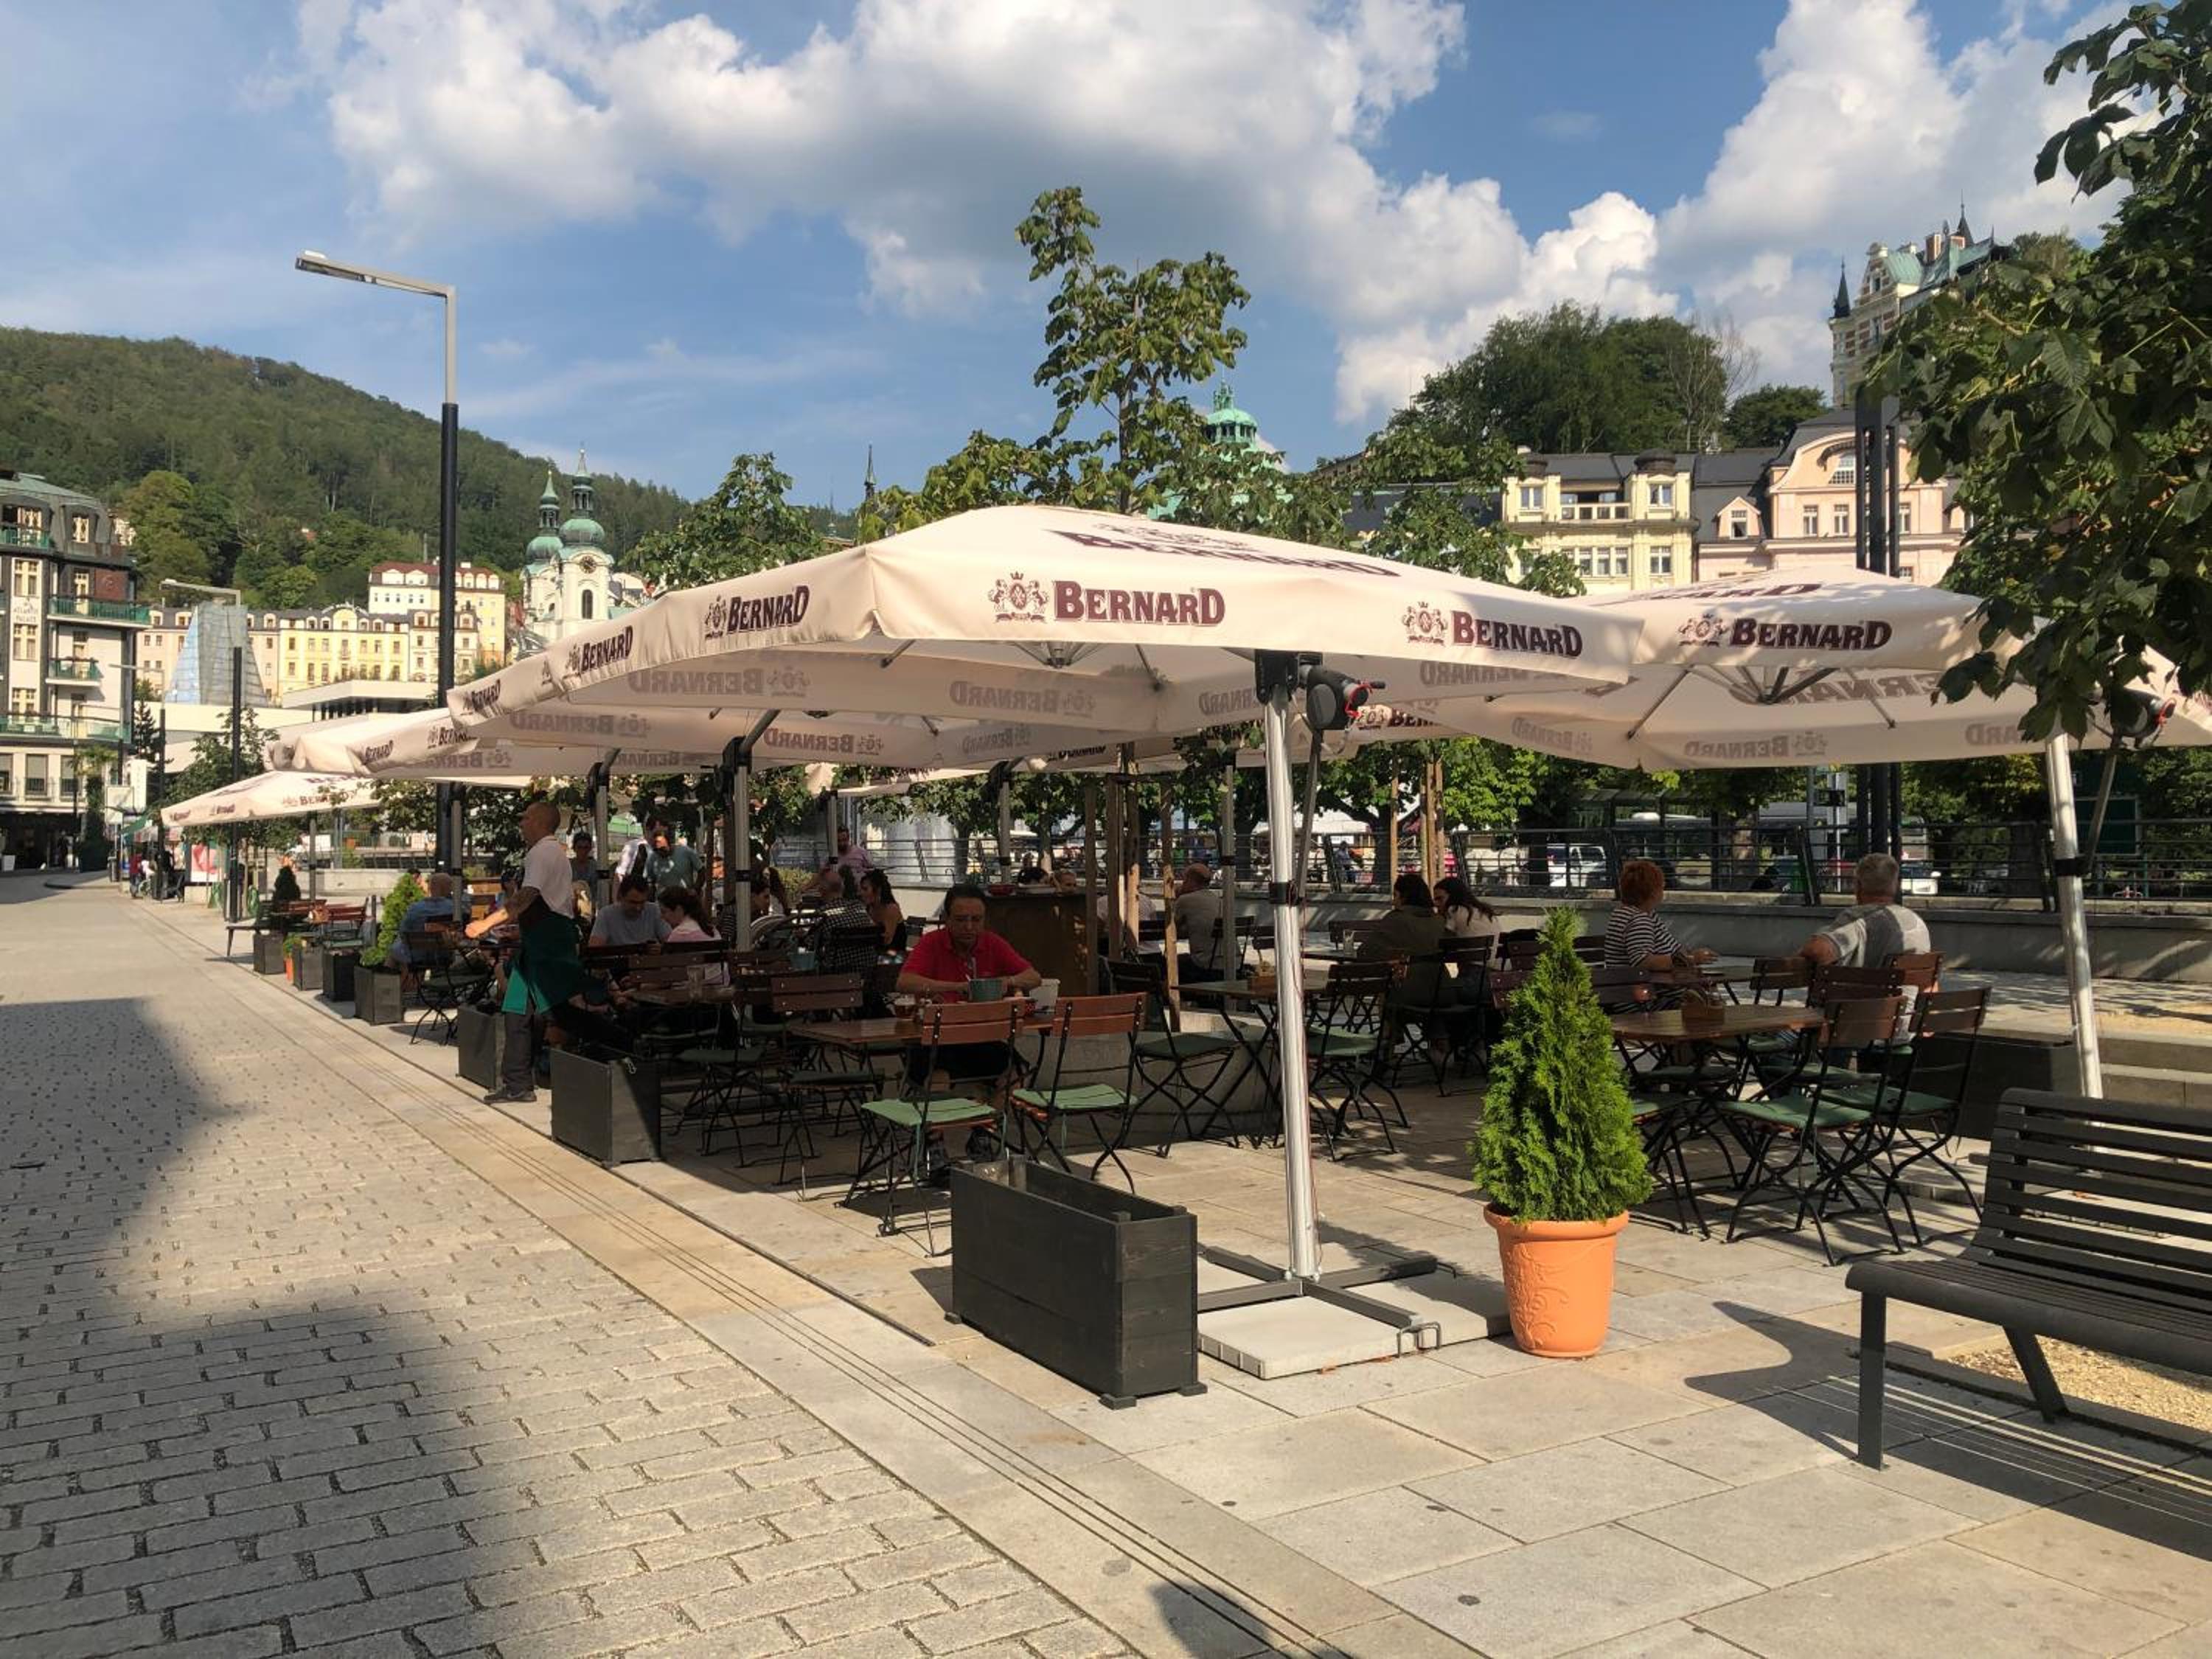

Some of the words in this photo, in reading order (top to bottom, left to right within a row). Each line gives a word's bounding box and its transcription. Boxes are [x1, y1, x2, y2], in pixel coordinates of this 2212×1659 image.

[727, 585, 810, 633] BERNARD
[1054, 580, 1225, 626] BERNARD
[581, 625, 633, 672] BERNARD
[1452, 610, 1583, 658] BERNARD
[1731, 618, 1892, 650] BERNARD
